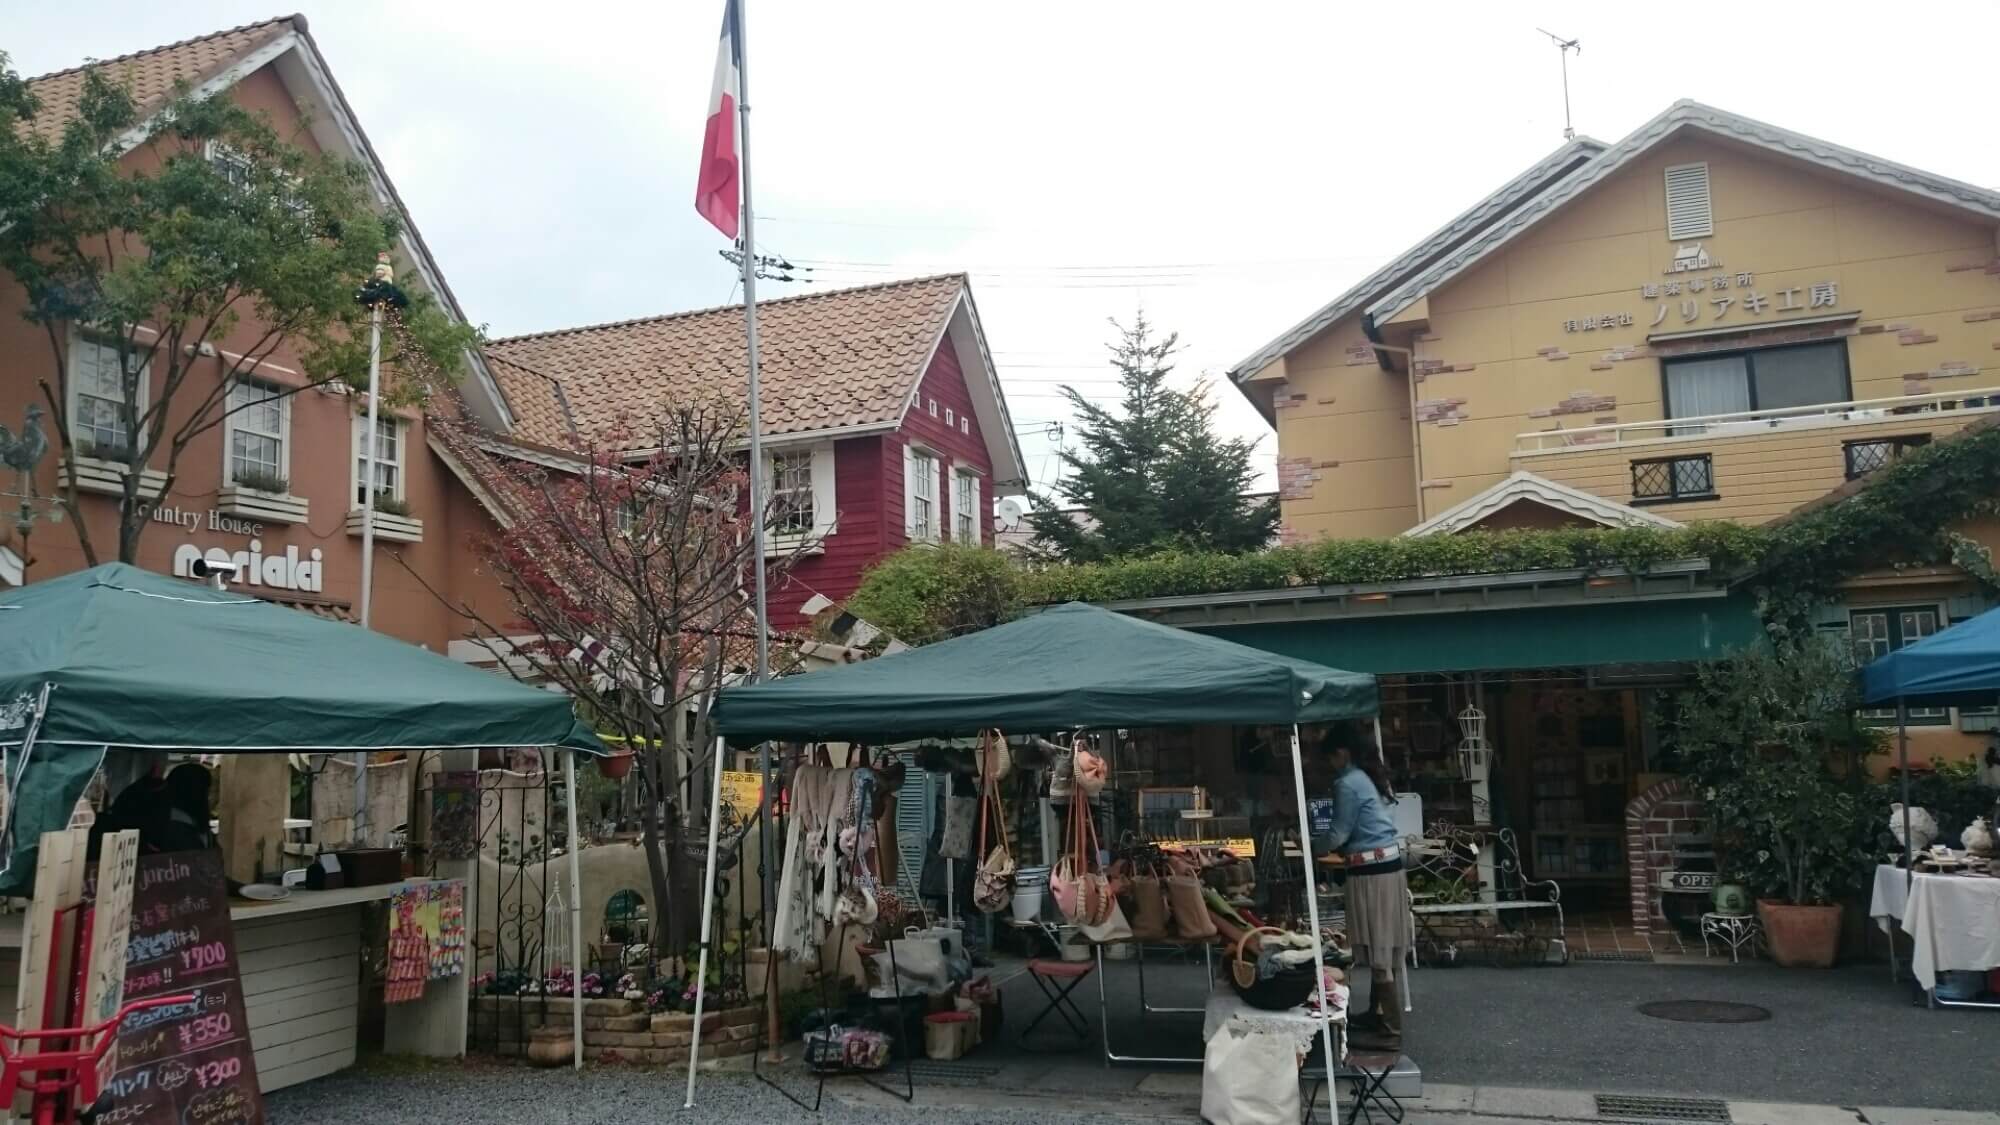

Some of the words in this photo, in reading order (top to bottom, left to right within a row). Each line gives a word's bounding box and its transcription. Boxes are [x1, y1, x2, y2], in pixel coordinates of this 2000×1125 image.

[1642, 271, 1753, 298] 建築事務所
[1563, 311, 1634, 333] 有限会社
[1651, 281, 1838, 327] ノリアキ工房
[120, 498, 202, 533] ountry
[208, 508, 263, 537] House
[138, 858, 190, 890] jardin
[180, 941, 226, 969] ¥700
[179, 1012, 231, 1044] ¥350
[104, 1070, 150, 1097] リンク
[195, 1057, 241, 1089] ¥300
